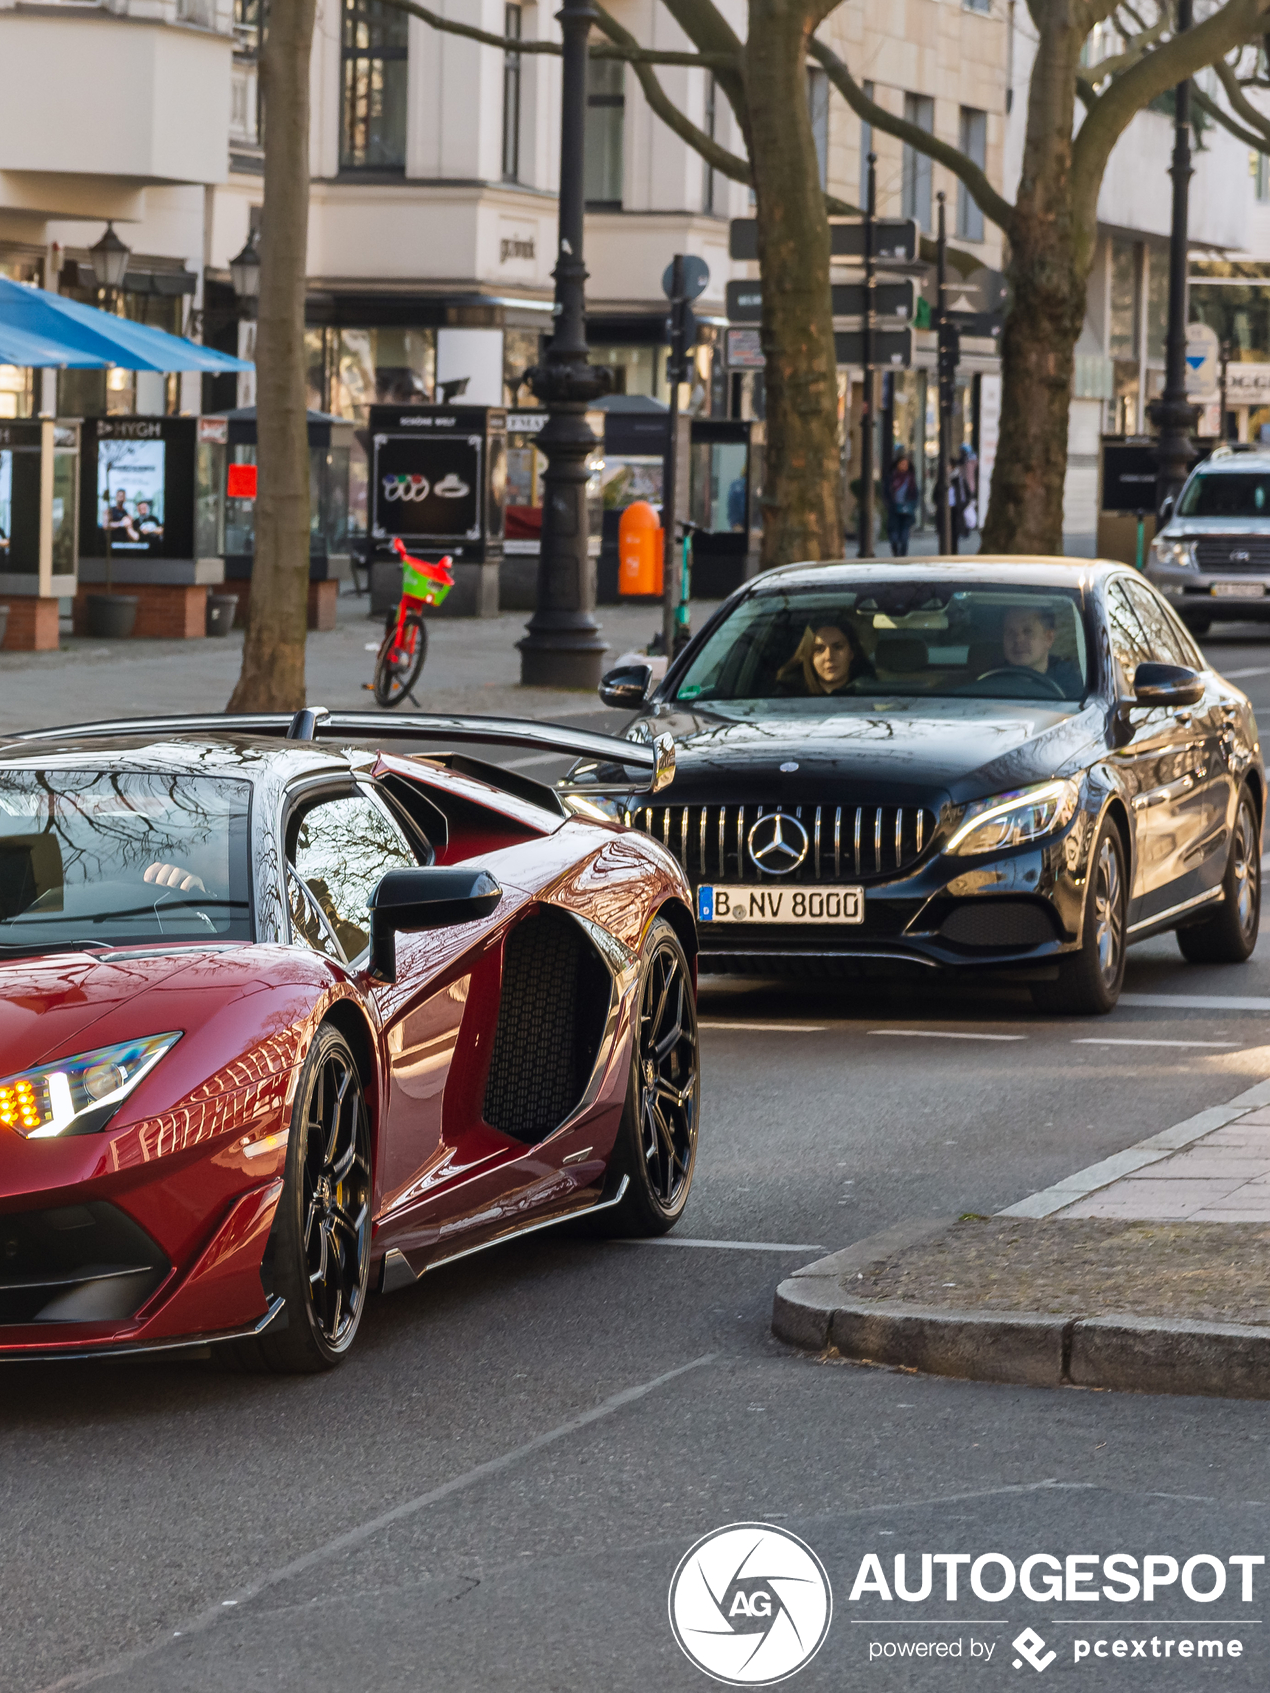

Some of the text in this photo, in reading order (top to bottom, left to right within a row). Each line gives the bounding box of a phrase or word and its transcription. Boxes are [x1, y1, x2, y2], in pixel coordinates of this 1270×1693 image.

[113, 421, 162, 438] HYGH
[715, 892, 730, 916] B
[749, 892, 783, 917] NV
[791, 892, 859, 918] 8000
